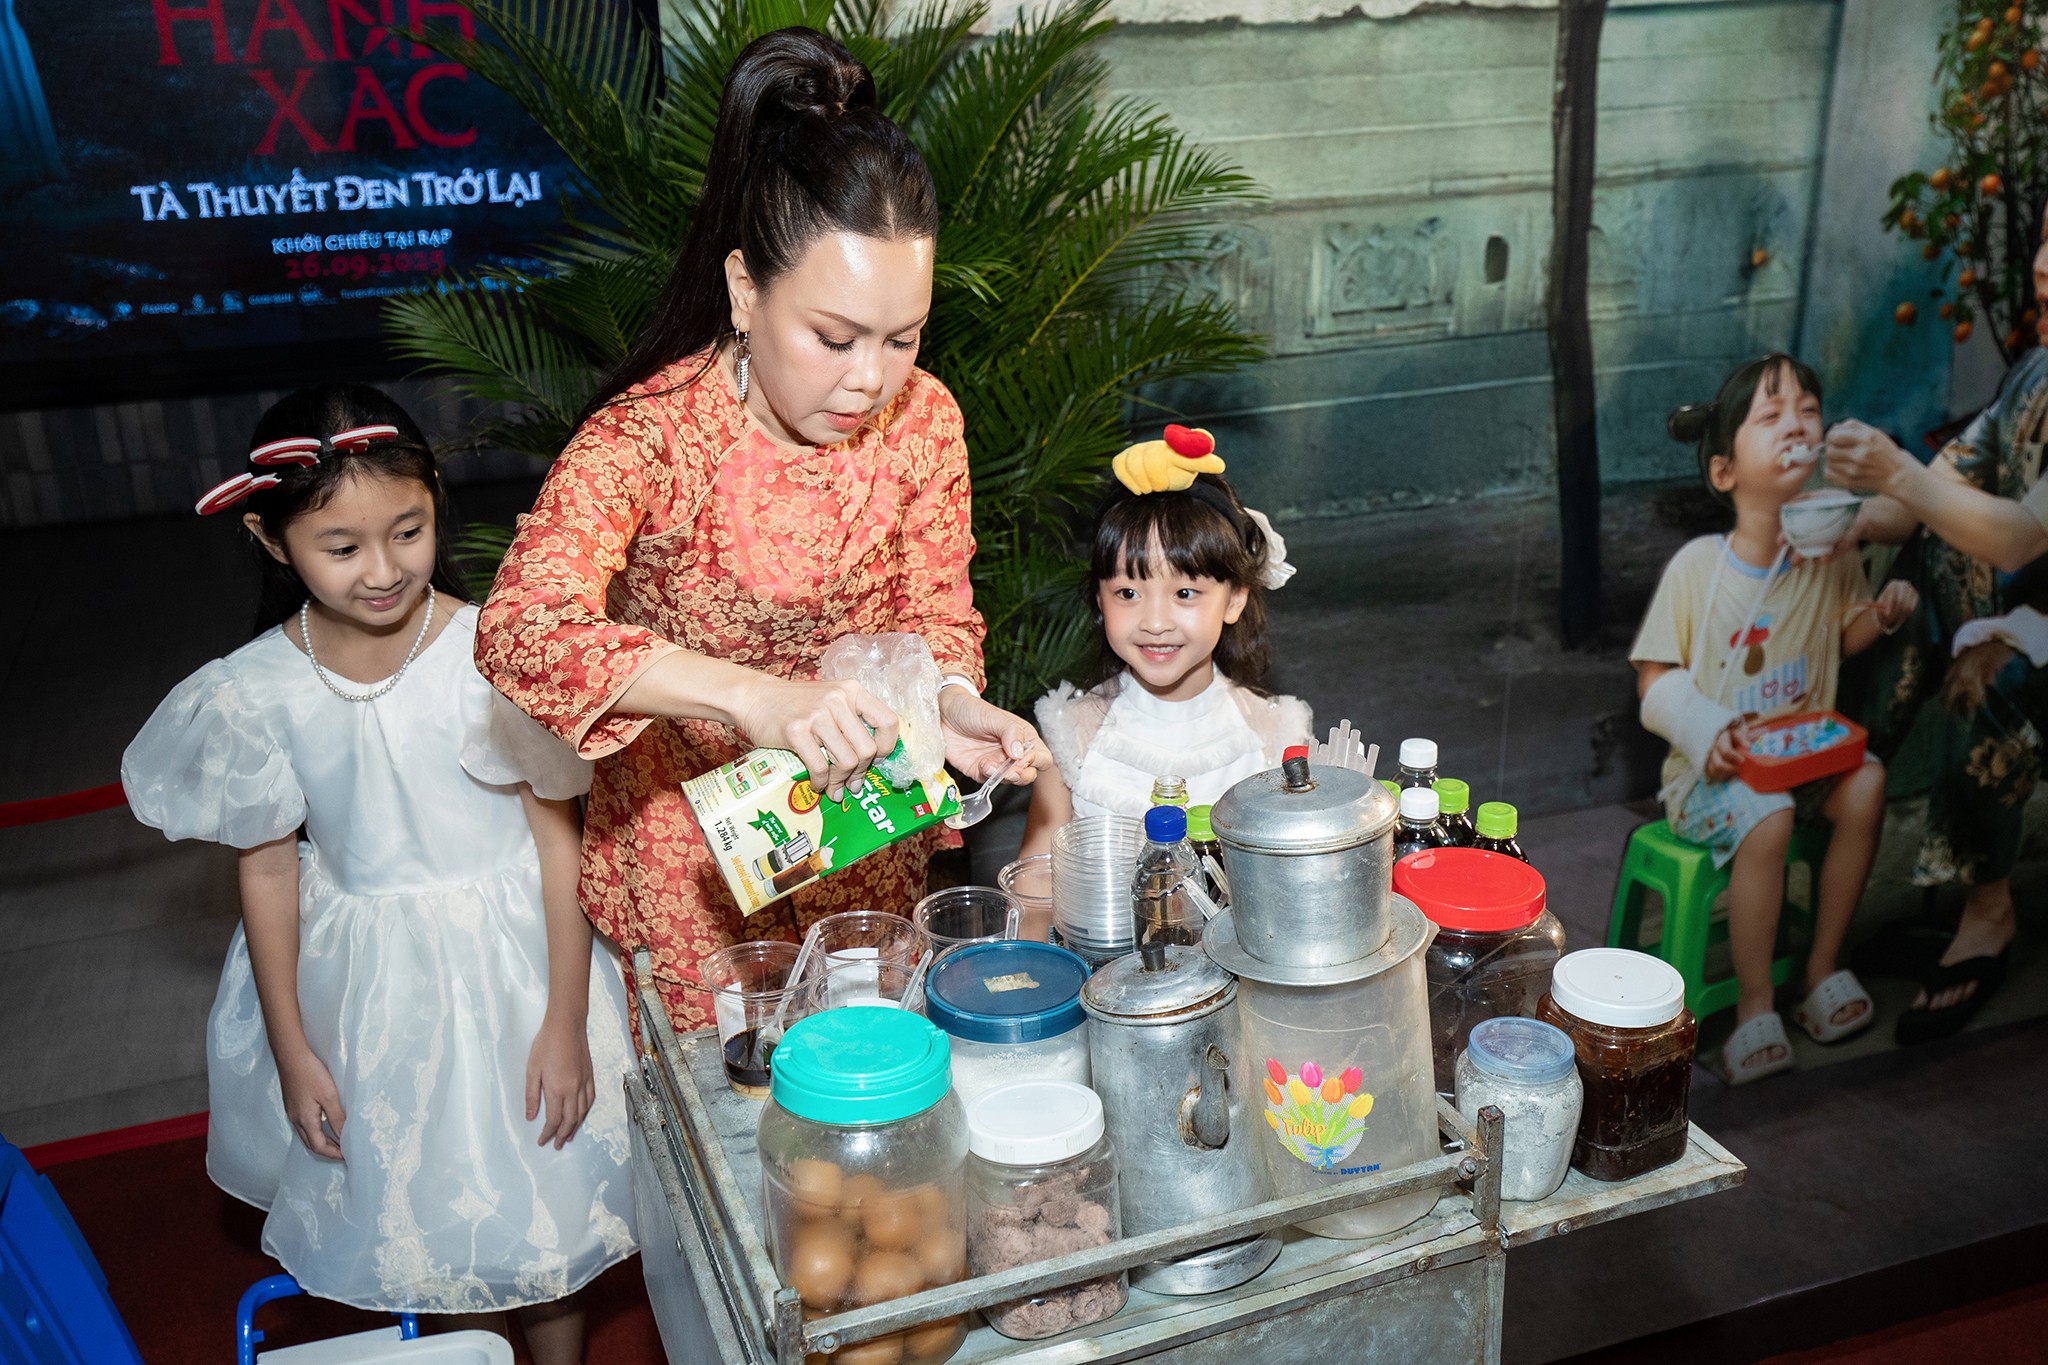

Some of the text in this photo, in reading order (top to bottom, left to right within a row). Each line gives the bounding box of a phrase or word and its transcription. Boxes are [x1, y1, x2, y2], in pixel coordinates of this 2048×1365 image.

[130, 180, 190, 221] TÀ
[333, 174, 411, 211] ĐEN
[411, 167, 485, 206] TRỞ
[486, 168, 543, 208] LẠI
[850, 780, 896, 834] Star
[725, 816, 740, 841] Net Weight
[1282, 1118, 1327, 1144] Tulip
